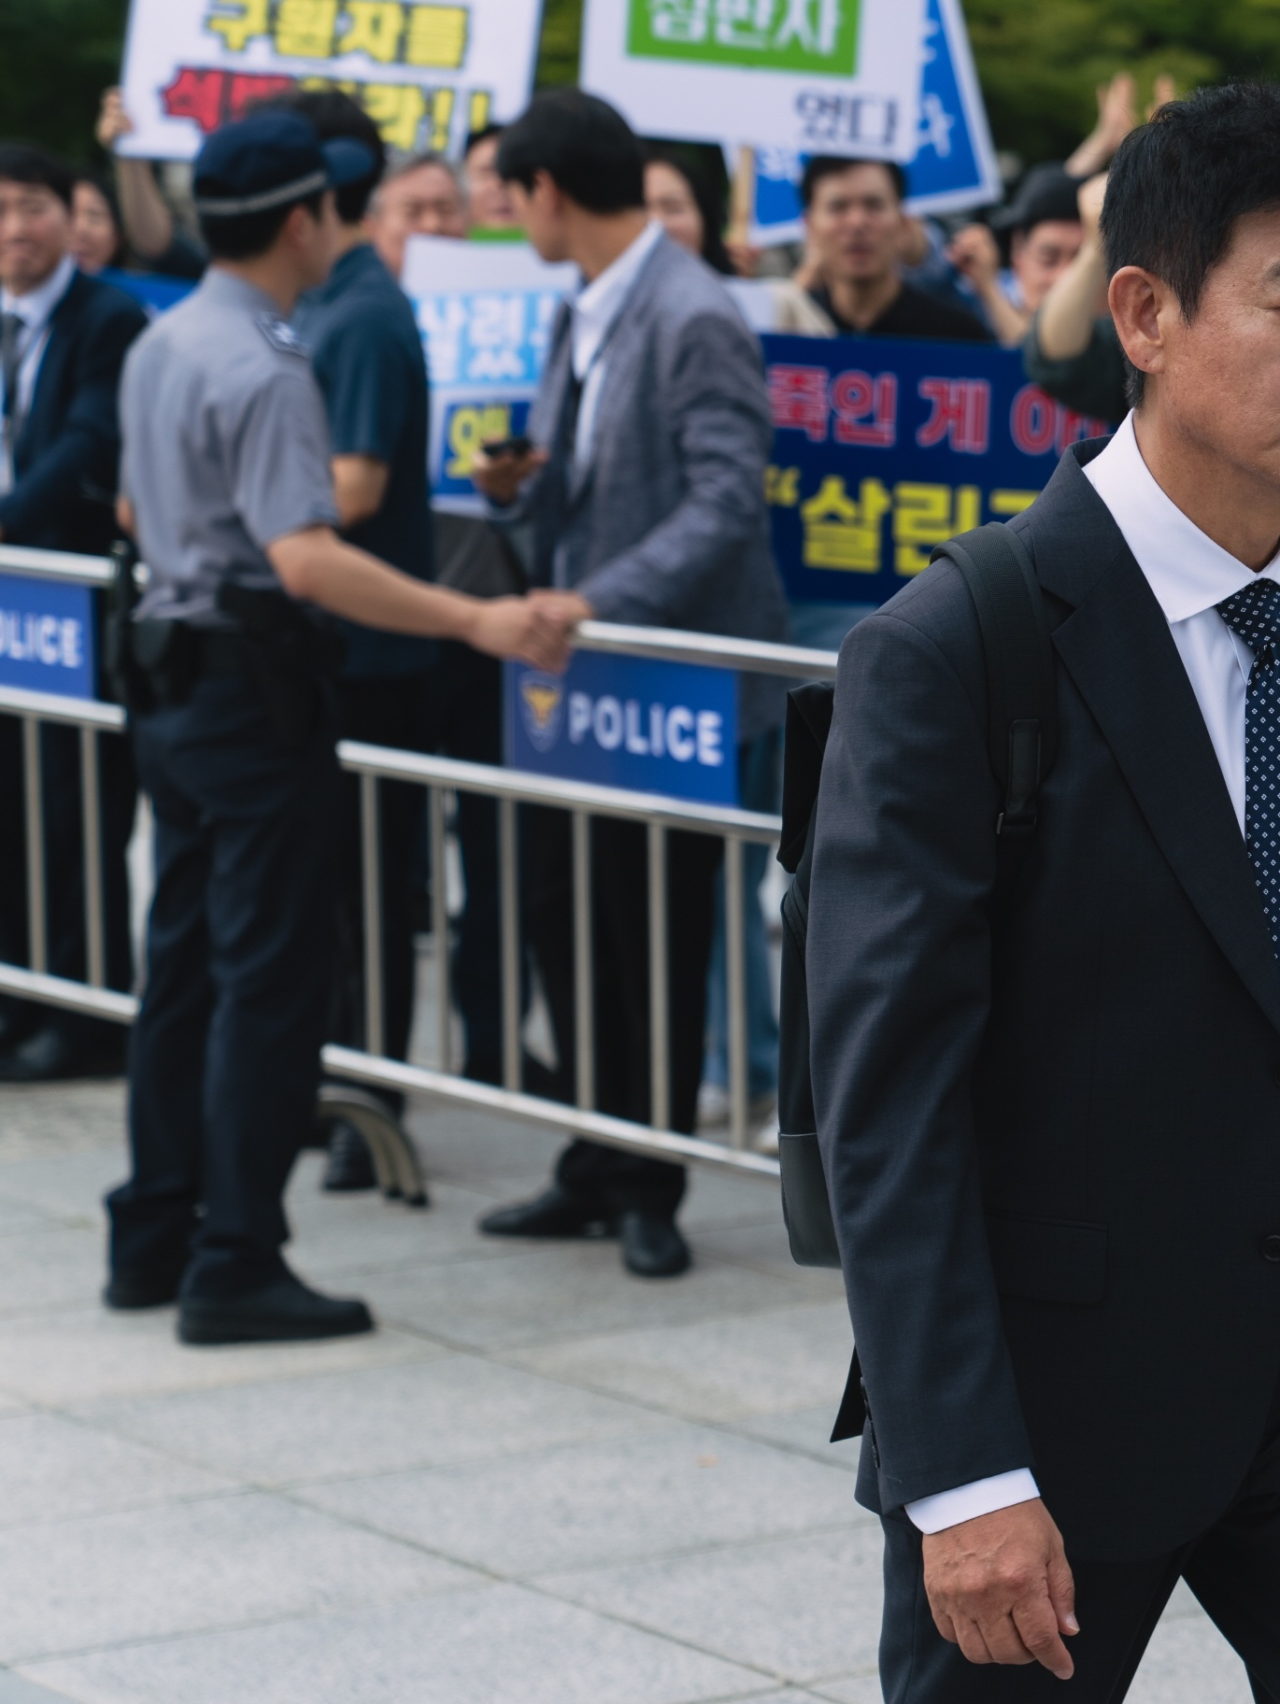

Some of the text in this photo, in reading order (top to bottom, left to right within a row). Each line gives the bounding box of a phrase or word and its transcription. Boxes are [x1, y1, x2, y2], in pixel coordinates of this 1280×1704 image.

[916, 377, 992, 455] 게
[1010, 383, 1108, 459] 아
[764, 464, 1040, 577] “살린
[0, 612, 82, 669] LICE
[567, 690, 726, 768] POLICE
